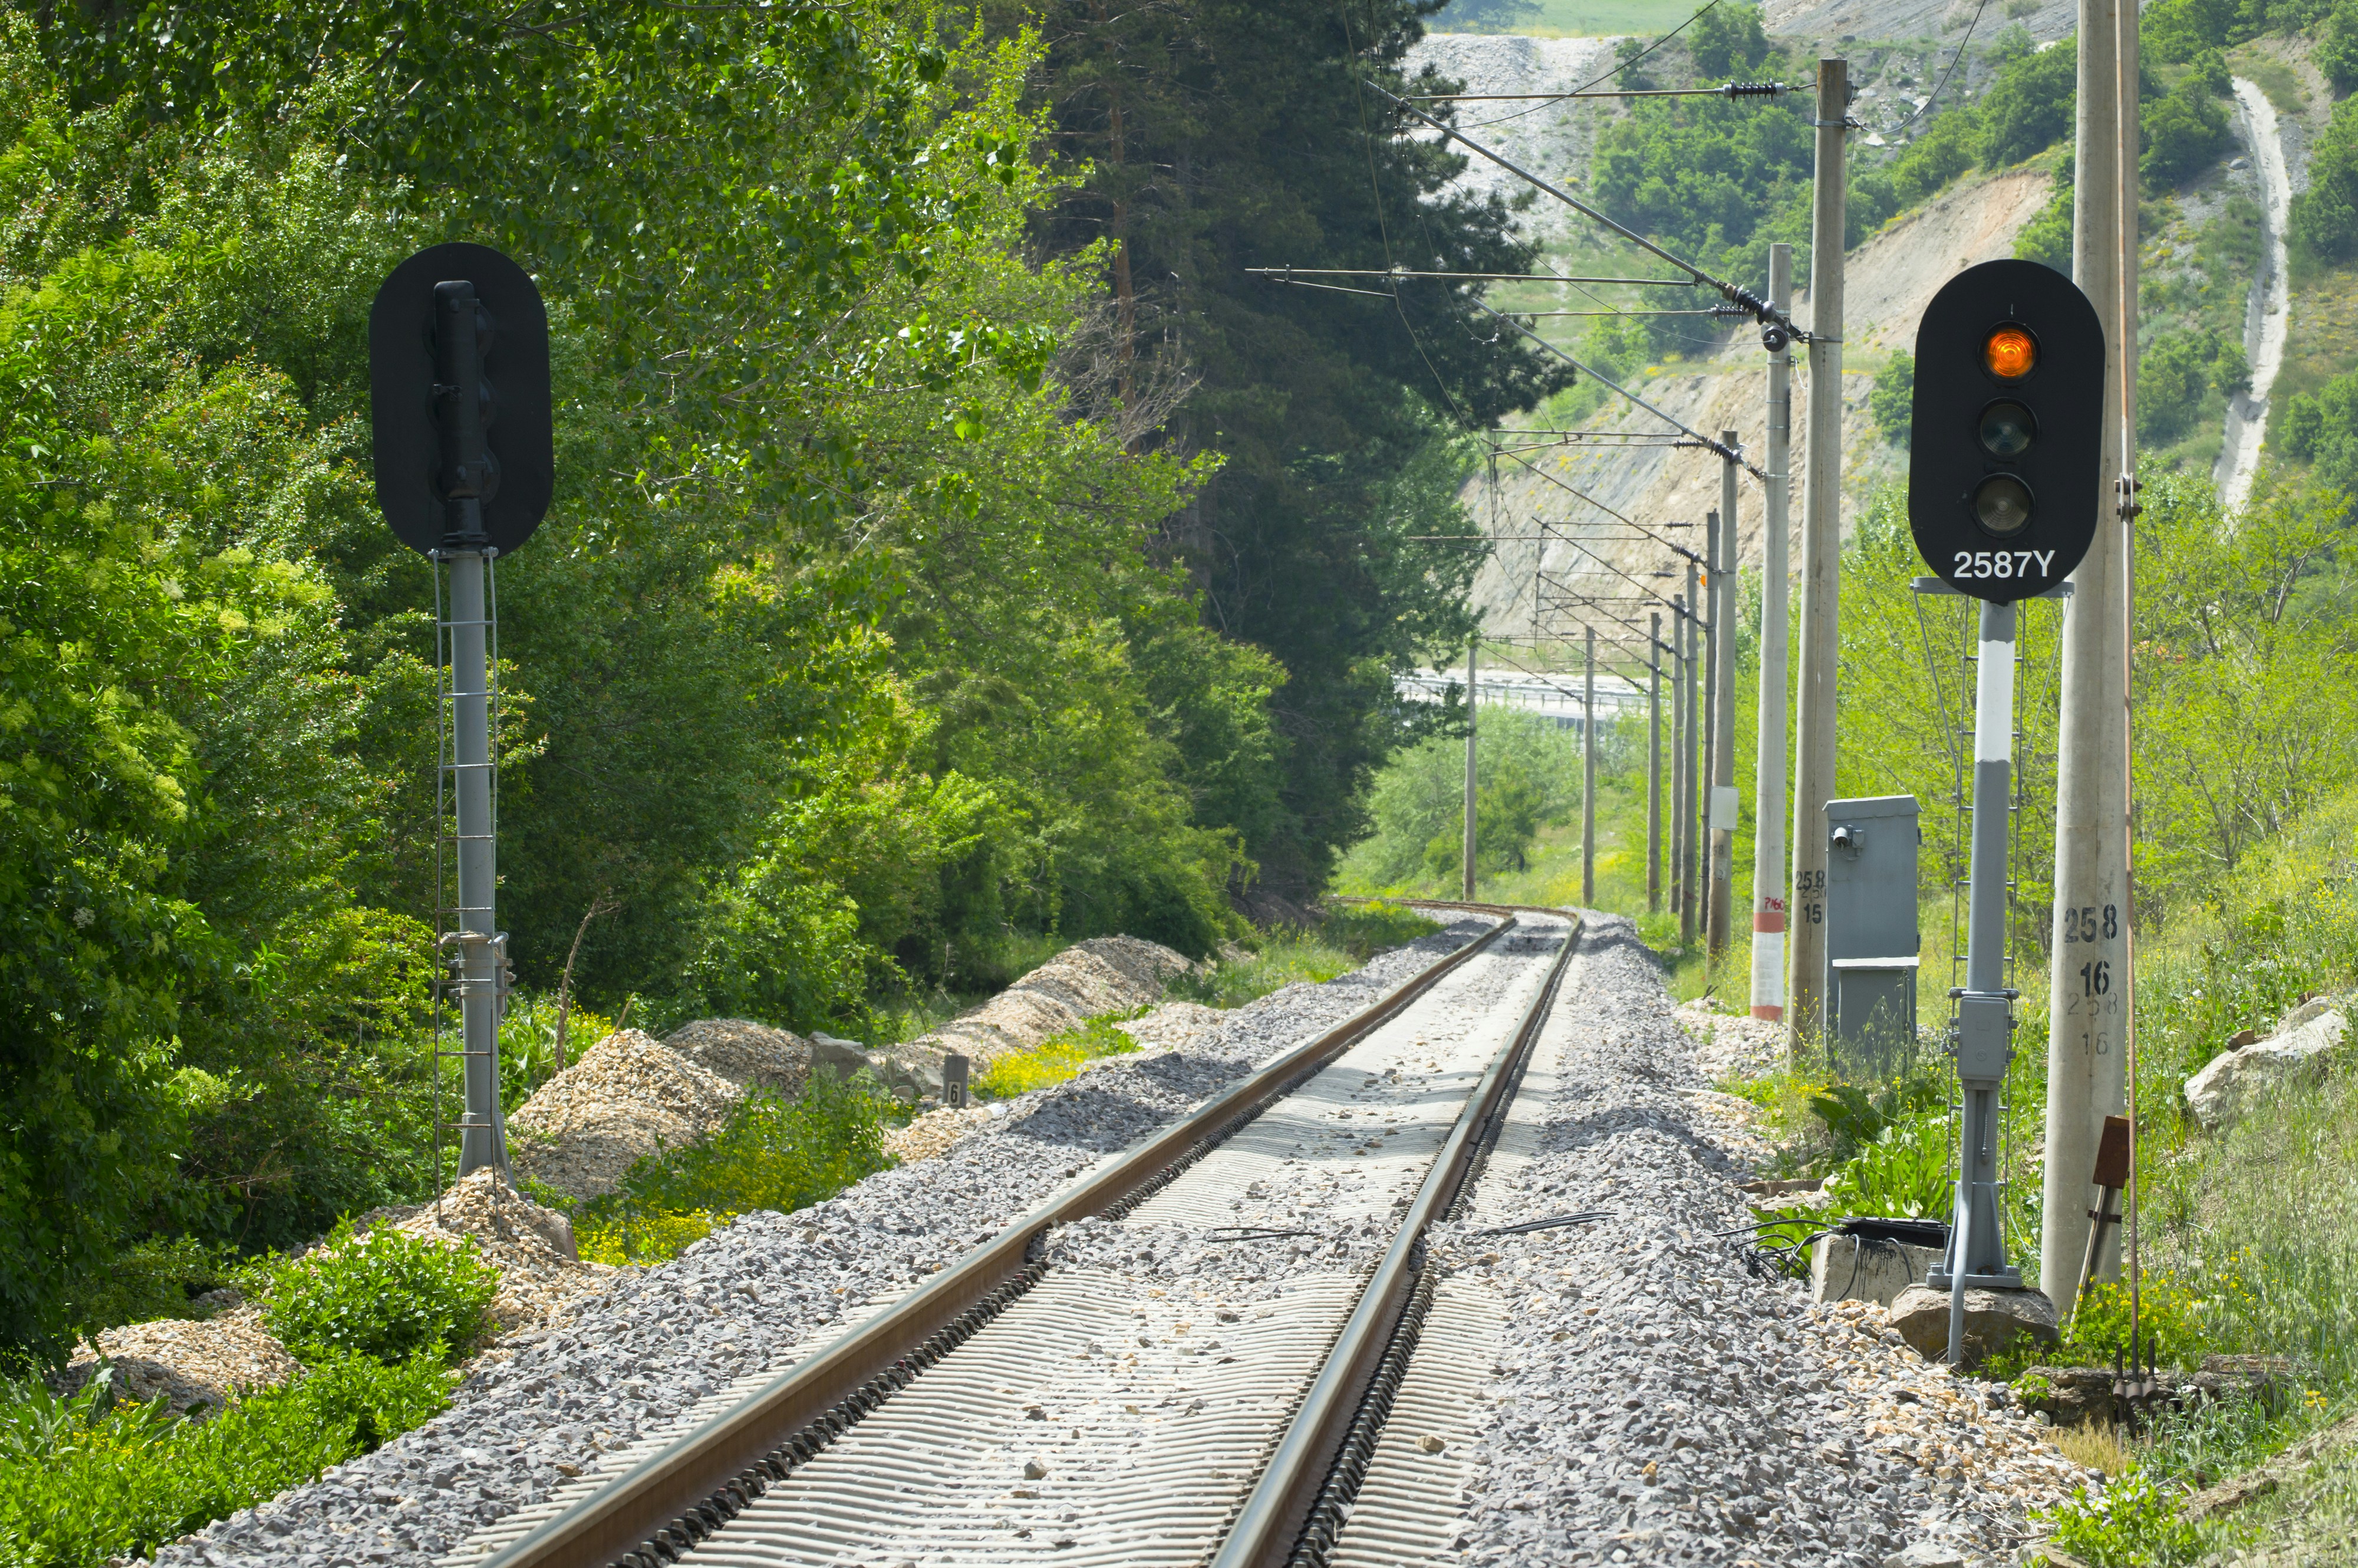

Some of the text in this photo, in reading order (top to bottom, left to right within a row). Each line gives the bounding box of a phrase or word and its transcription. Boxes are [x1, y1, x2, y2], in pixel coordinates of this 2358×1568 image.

[1954, 550, 2056, 578] 2587Y
[1796, 869, 1825, 890] 258
[1804, 903, 1822, 924] 15
[2064, 904, 2117, 943] 258
[2080, 960, 2110, 997] 16
[2082, 1032, 2108, 1055] 16
[950, 1083, 958, 1103] 6
